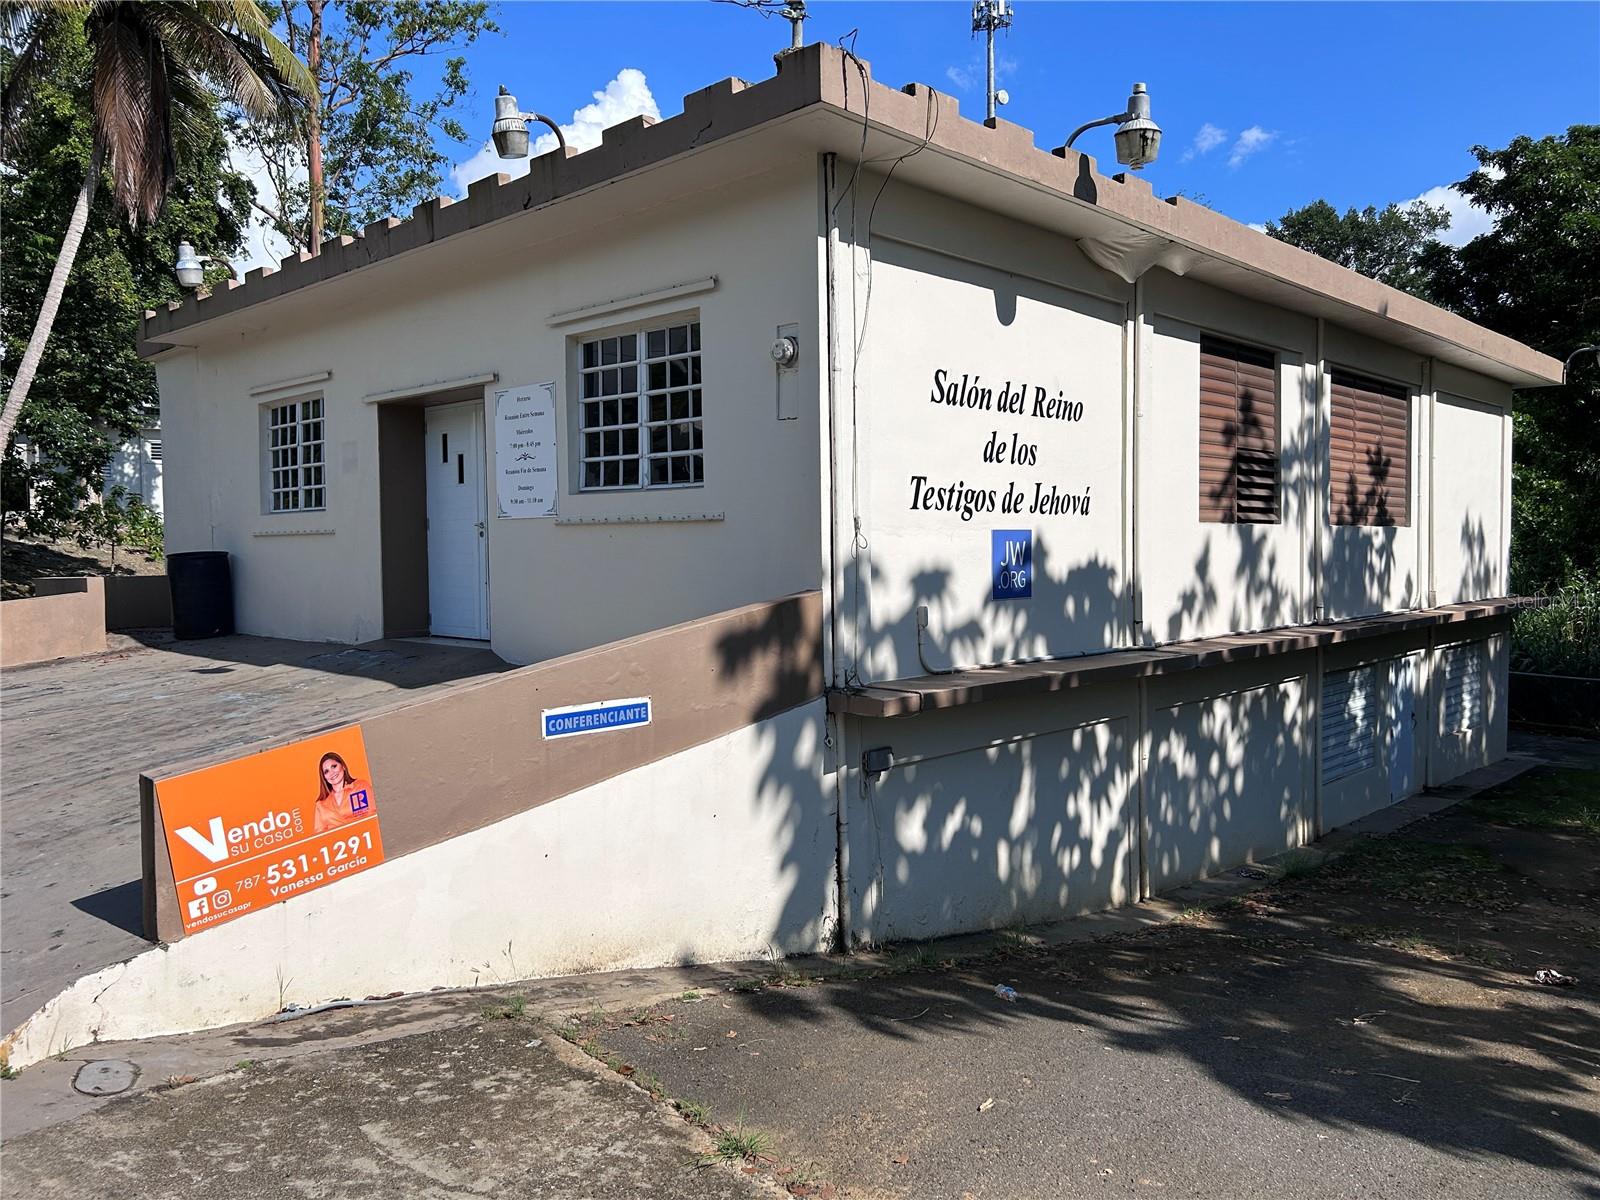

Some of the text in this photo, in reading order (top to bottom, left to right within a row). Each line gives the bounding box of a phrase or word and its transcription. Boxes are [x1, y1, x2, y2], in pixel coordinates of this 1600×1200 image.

[930, 369, 1084, 422] Salón del Reino
[983, 431, 1038, 466] de los
[910, 475, 1091, 521] Testigos de Jehová
[1000, 540, 1026, 566] JW
[998, 570, 1026, 589] .ORG
[548, 706, 647, 732] CONFERENCIANTE
[174, 810, 291, 863] Vendo
[231, 827, 294, 856] su casa
[270, 855, 368, 897] Vanessa García
[186, 901, 252, 929] vendosucasapr
